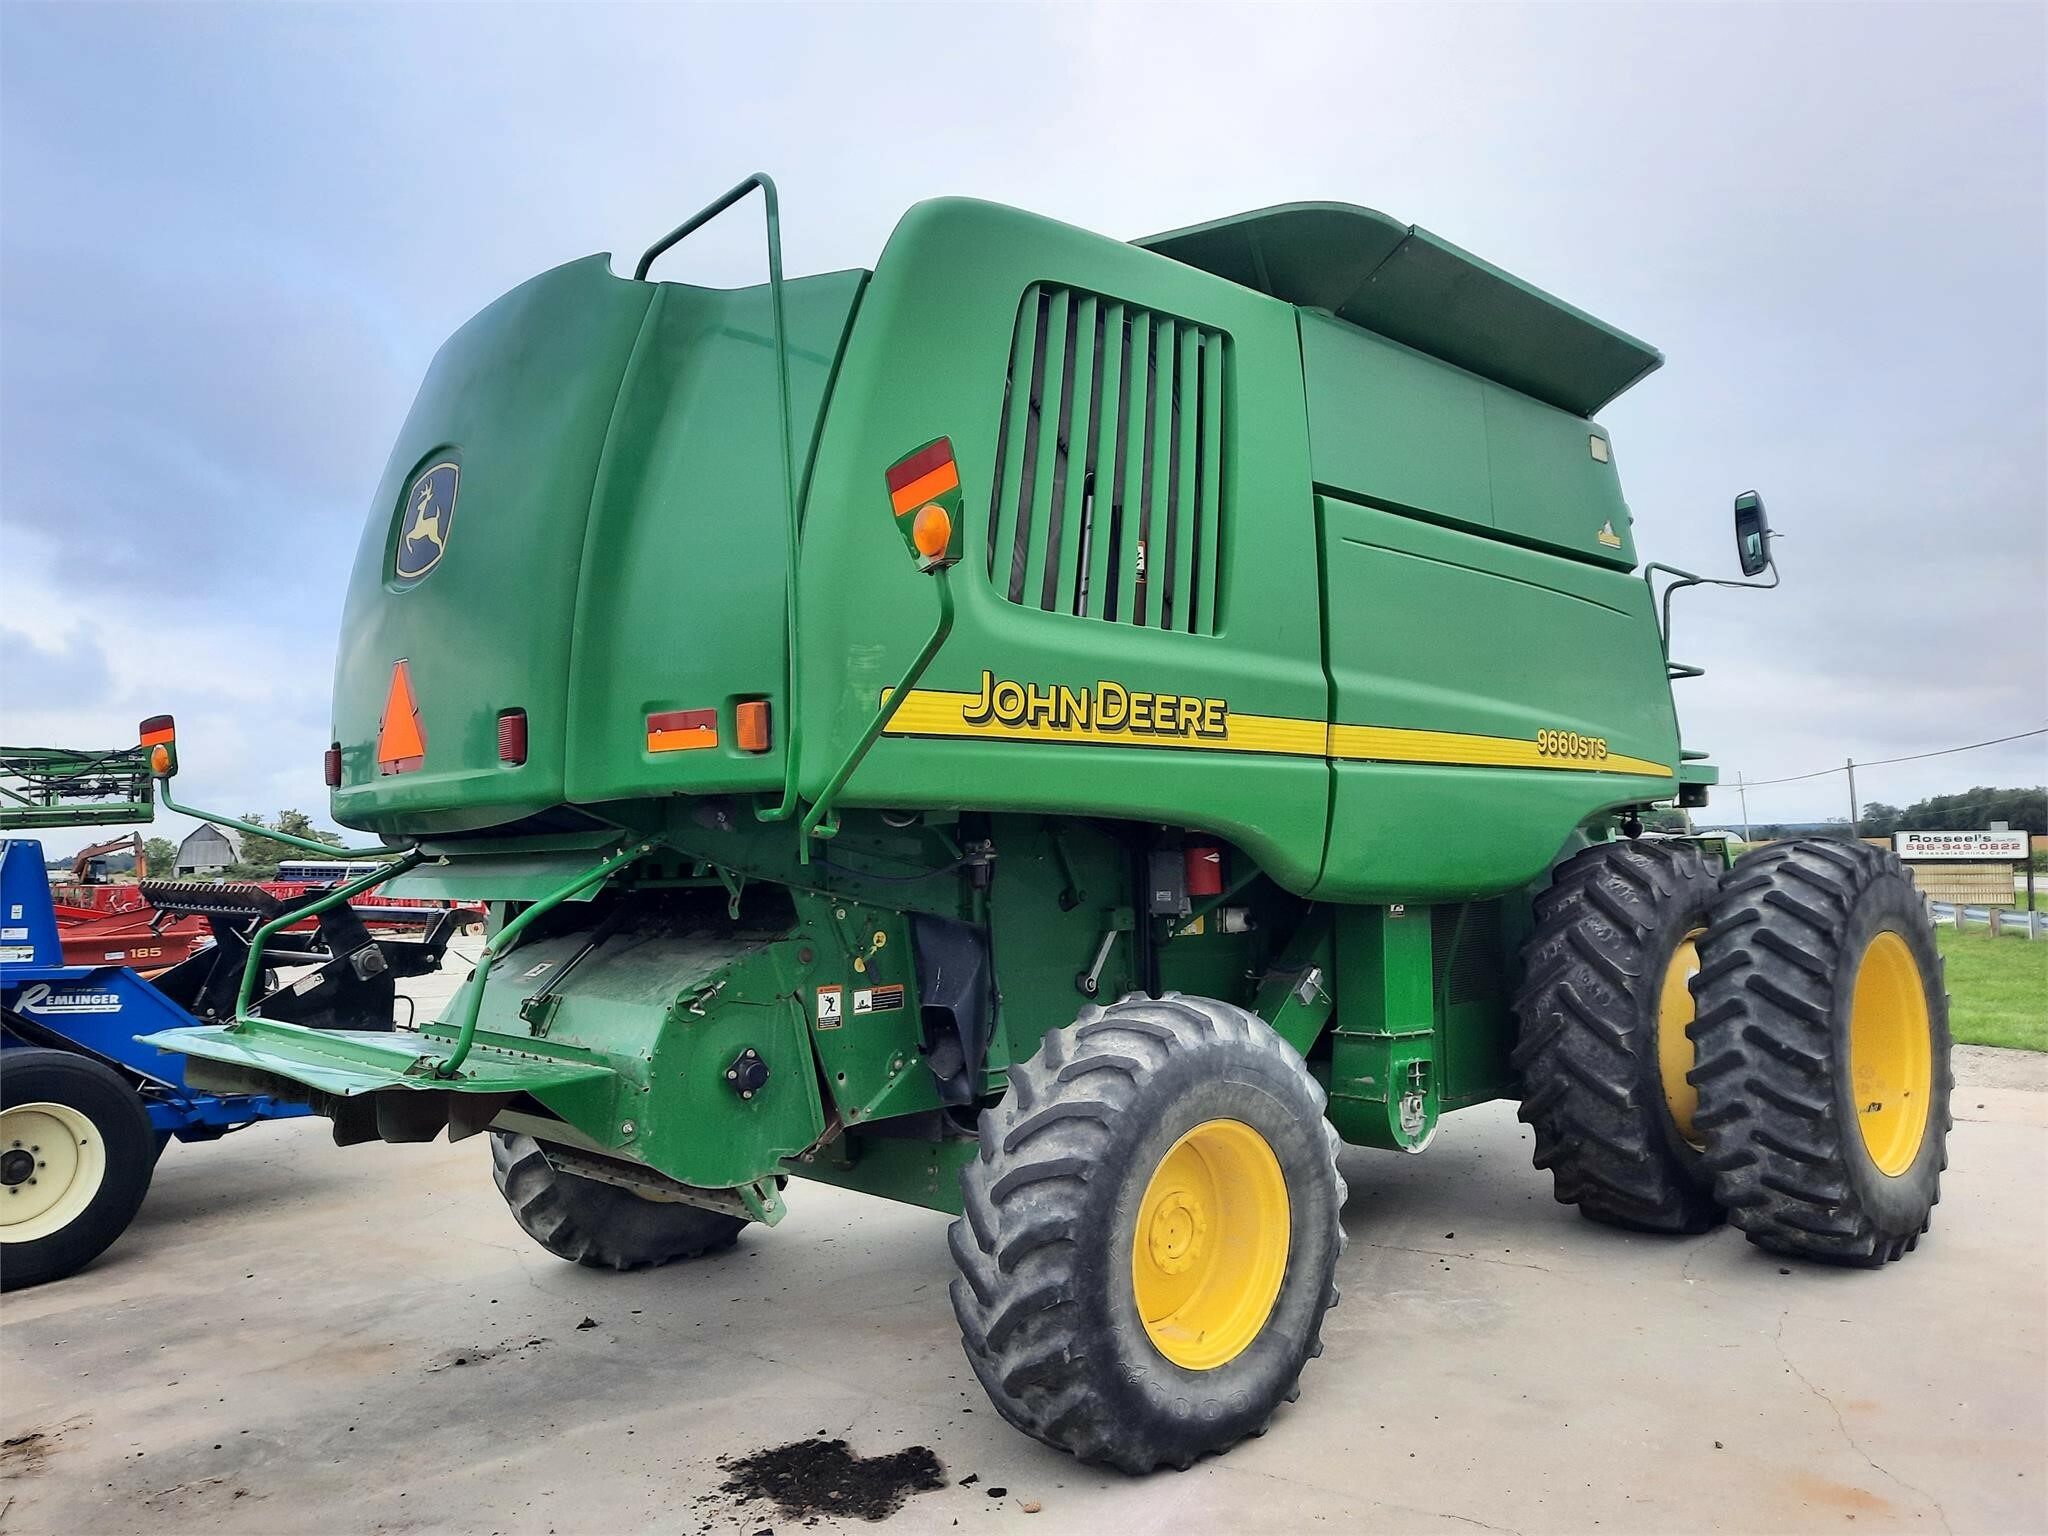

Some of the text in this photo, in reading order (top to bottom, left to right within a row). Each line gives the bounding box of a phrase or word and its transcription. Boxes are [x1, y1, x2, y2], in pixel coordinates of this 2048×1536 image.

[963, 670, 1228, 741] JOHN DEERE
[1537, 728, 1608, 760] 9660STS
[1909, 834, 1992, 842] Rosseel's
[130, 947, 162, 959] 185
[13, 983, 120, 1014] REMLINGER
